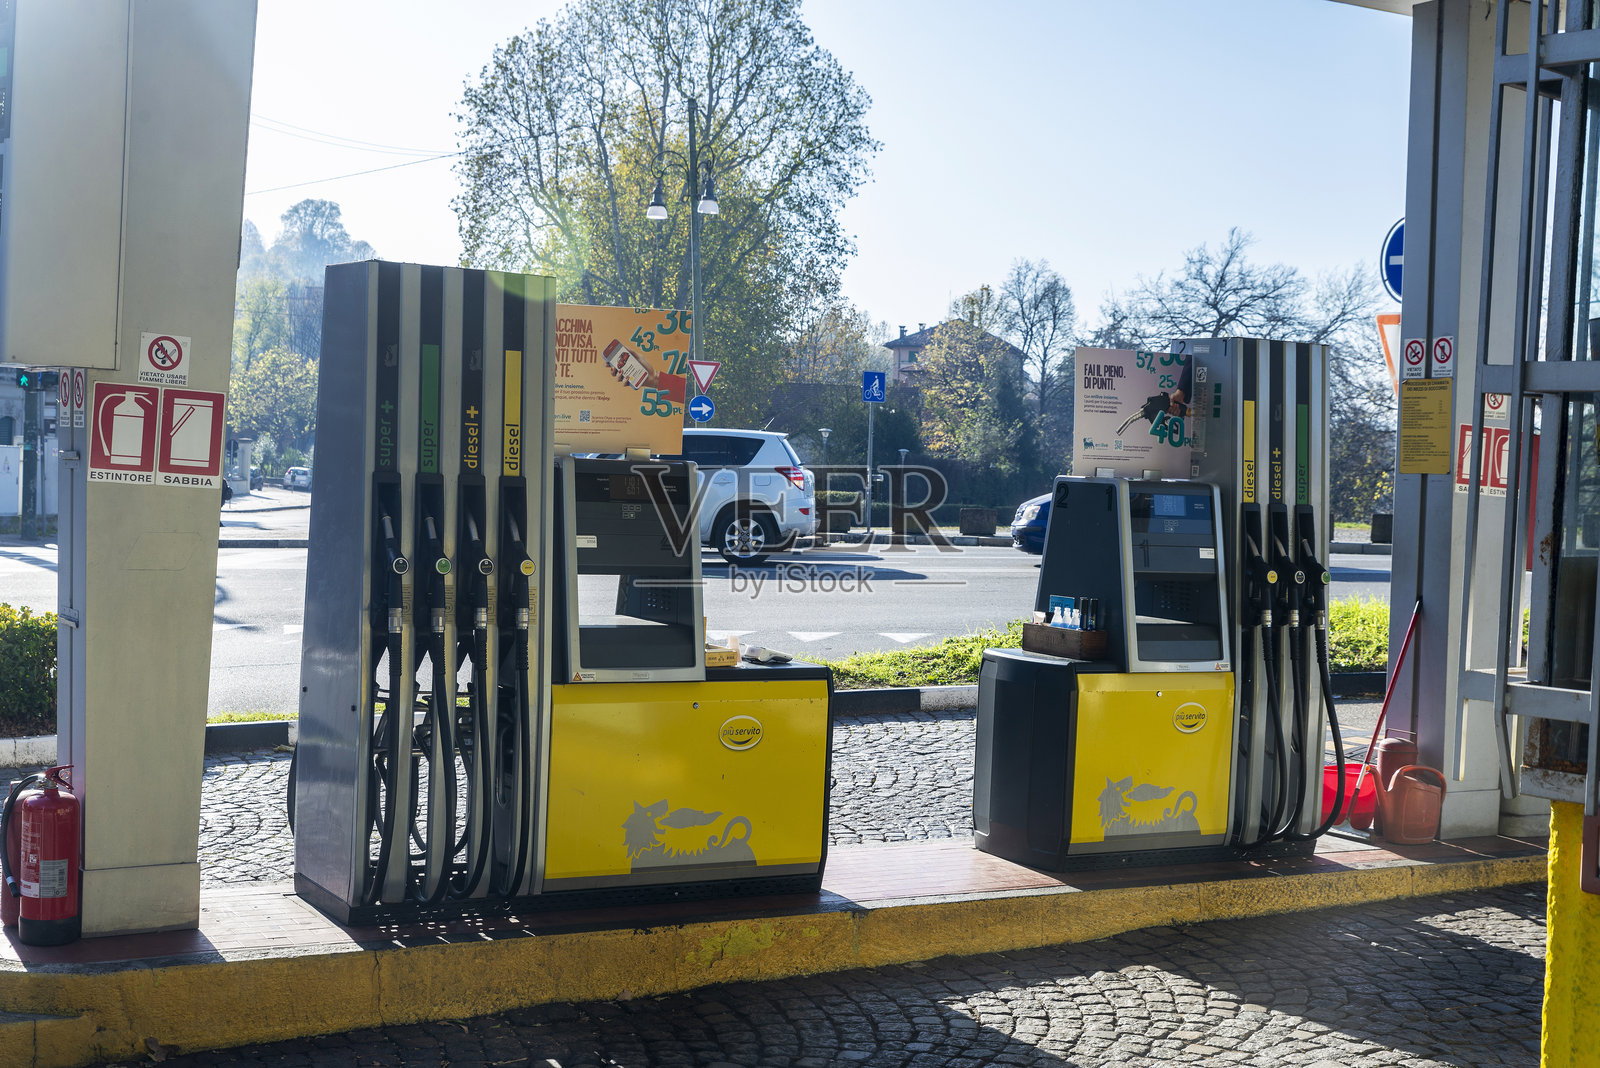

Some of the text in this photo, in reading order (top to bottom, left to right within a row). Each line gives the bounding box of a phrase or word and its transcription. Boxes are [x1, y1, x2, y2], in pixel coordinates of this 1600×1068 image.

[571, 349, 597, 363] TUTTI
[139, 376, 187, 386] FIAMME LIBERE
[140, 371, 188, 381] VIETATO USARE
[1084, 363, 1126, 379] FAI IL PIENO.
[1084, 377, 1116, 391] DI PUNTI.
[380, 418, 394, 467] super
[423, 419, 437, 468] super
[463, 422, 479, 469] diesel
[504, 423, 519, 470] diesel
[90, 471, 152, 483] ESTINTORE
[163, 475, 213, 487] SABBIA
[1244, 460, 1254, 499] diesel
[1271, 461, 1282, 500] diesel
[1298, 464, 1308, 501] super
[1056, 483, 1069, 508] 2
[1105, 485, 1113, 512] 1
[1185, 711, 1205, 720] servito
[722, 725, 761, 738] più servito
